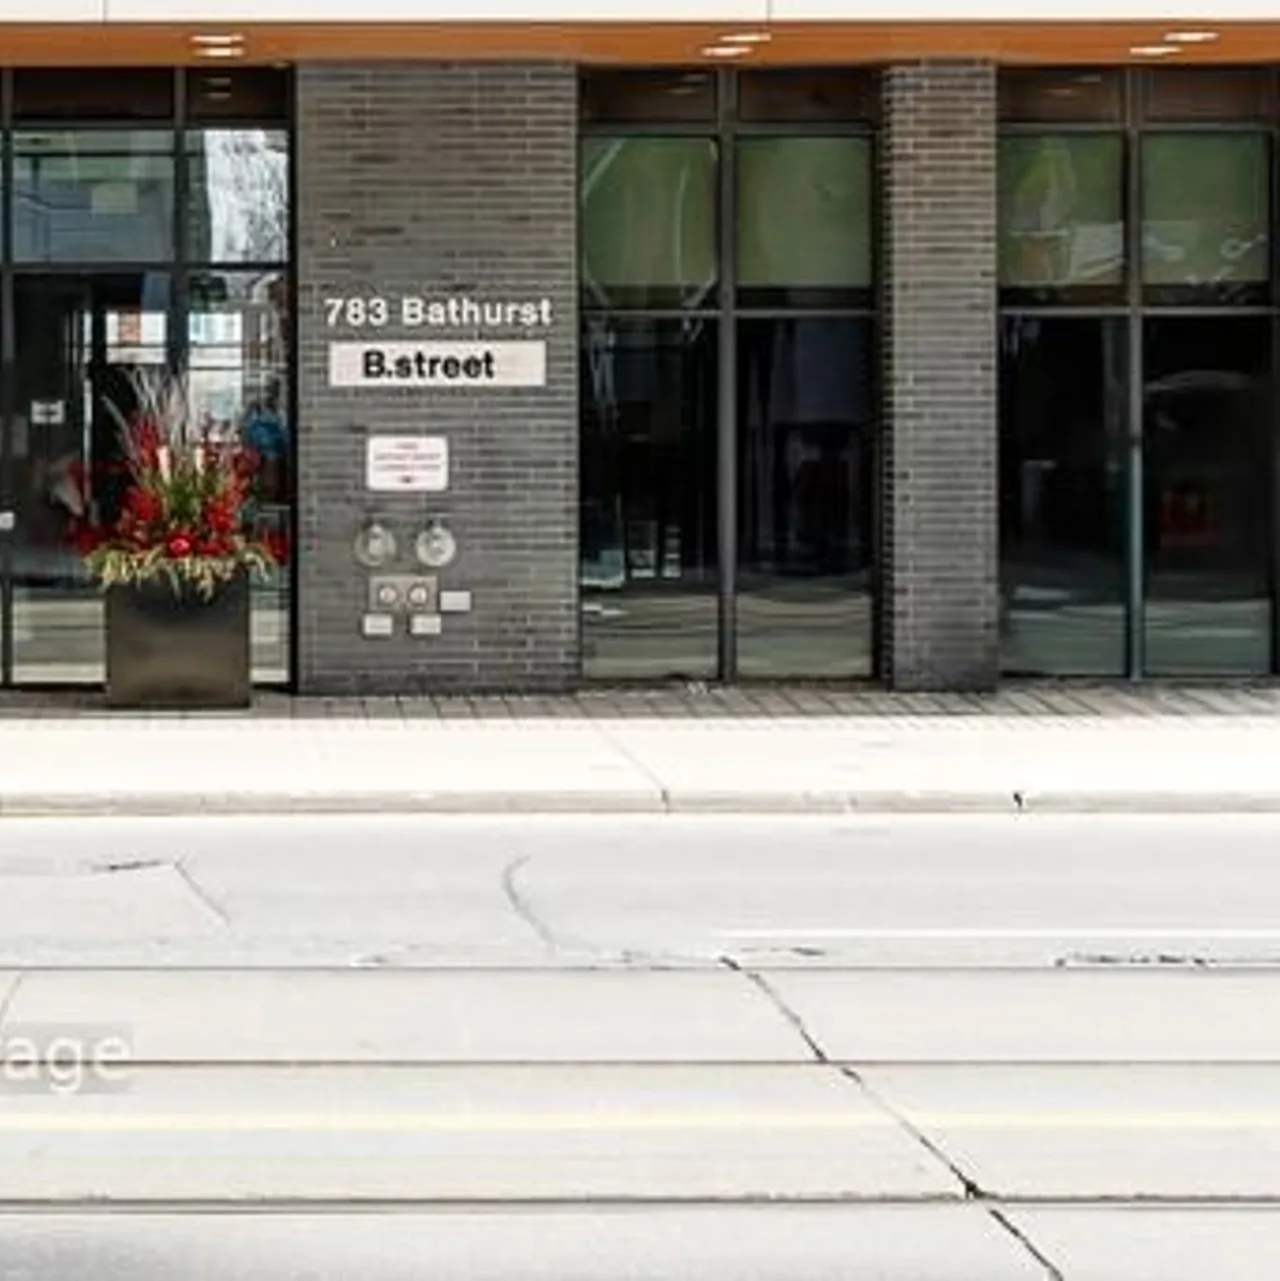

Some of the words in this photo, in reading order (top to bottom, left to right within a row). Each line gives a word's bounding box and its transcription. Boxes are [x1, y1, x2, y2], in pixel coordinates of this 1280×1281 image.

[323, 297, 388, 326] 783
[401, 297, 553, 326] Bathurst
[362, 350, 495, 379] B.street
